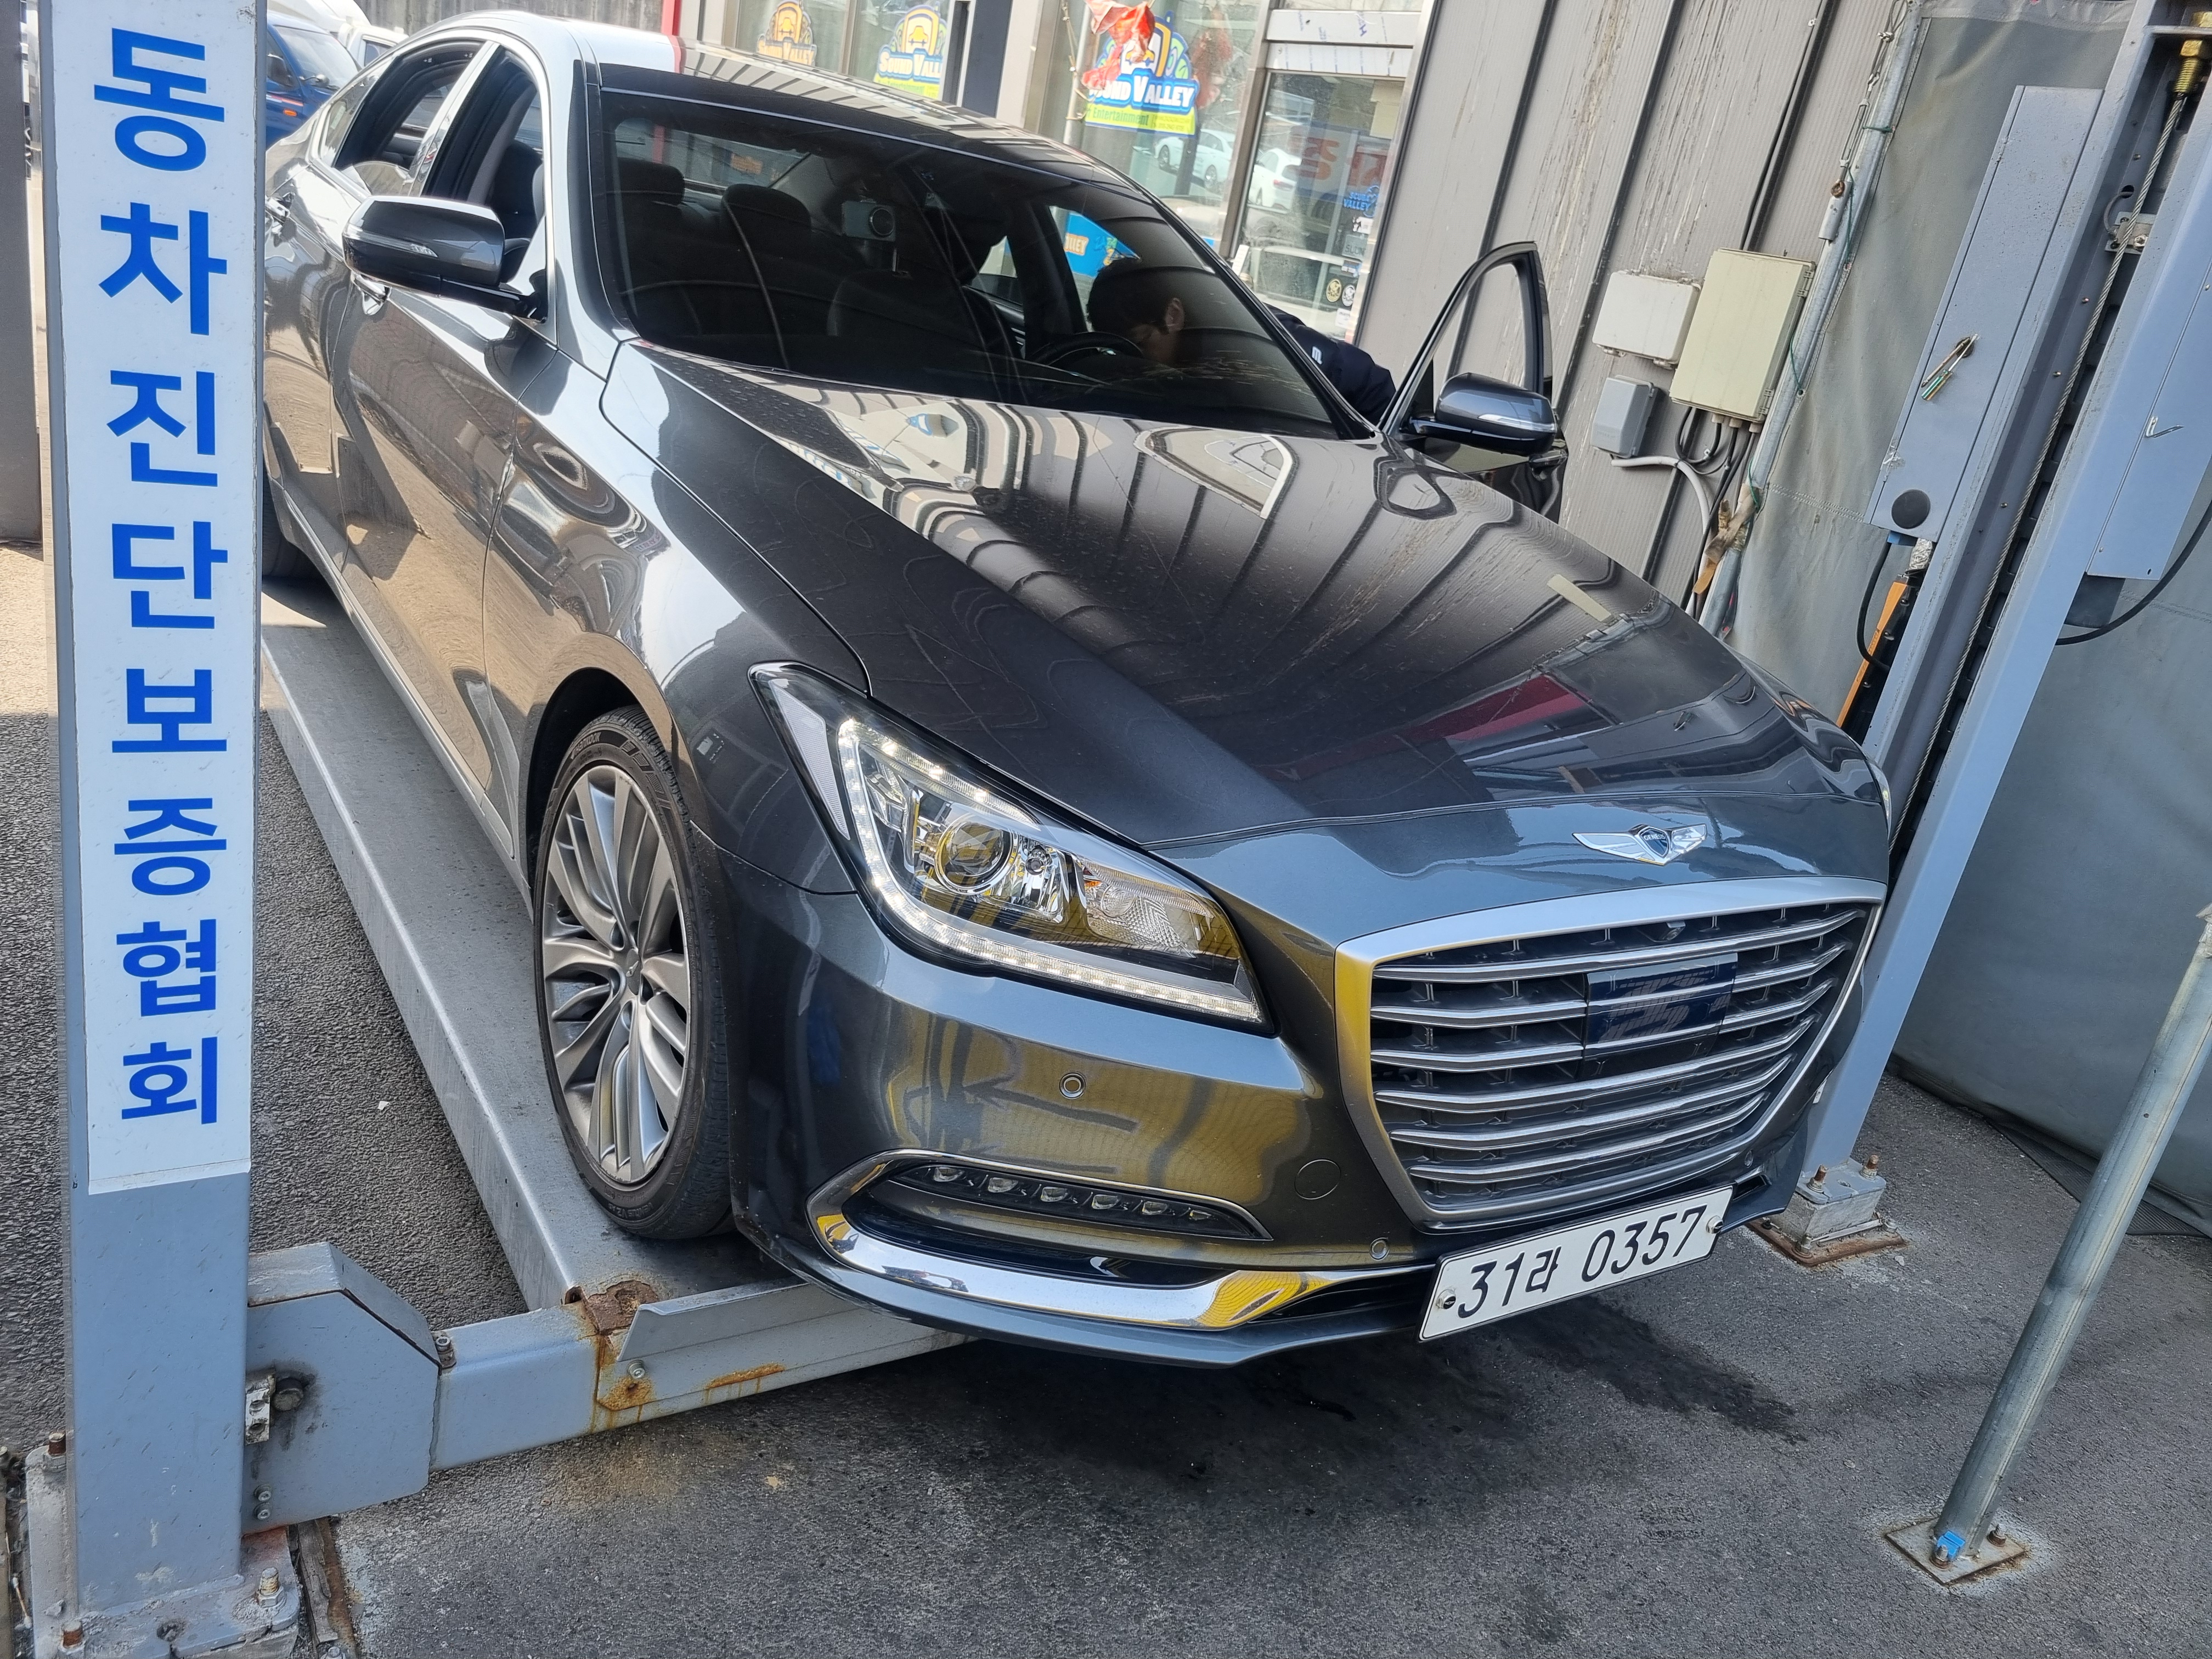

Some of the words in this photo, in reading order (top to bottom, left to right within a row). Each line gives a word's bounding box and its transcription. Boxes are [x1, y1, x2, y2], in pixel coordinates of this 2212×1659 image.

[879, 51, 913, 75] SOUND
[1133, 76, 1195, 108] VALLEY
[1093, 107, 1149, 126] Entertainment
[1344, 199, 1370, 211] VALLEY
[1349, 192, 1370, 201] SCUBA
[1457, 1246, 1561, 1319] 31라
[1581, 1204, 1707, 1283] 0357
